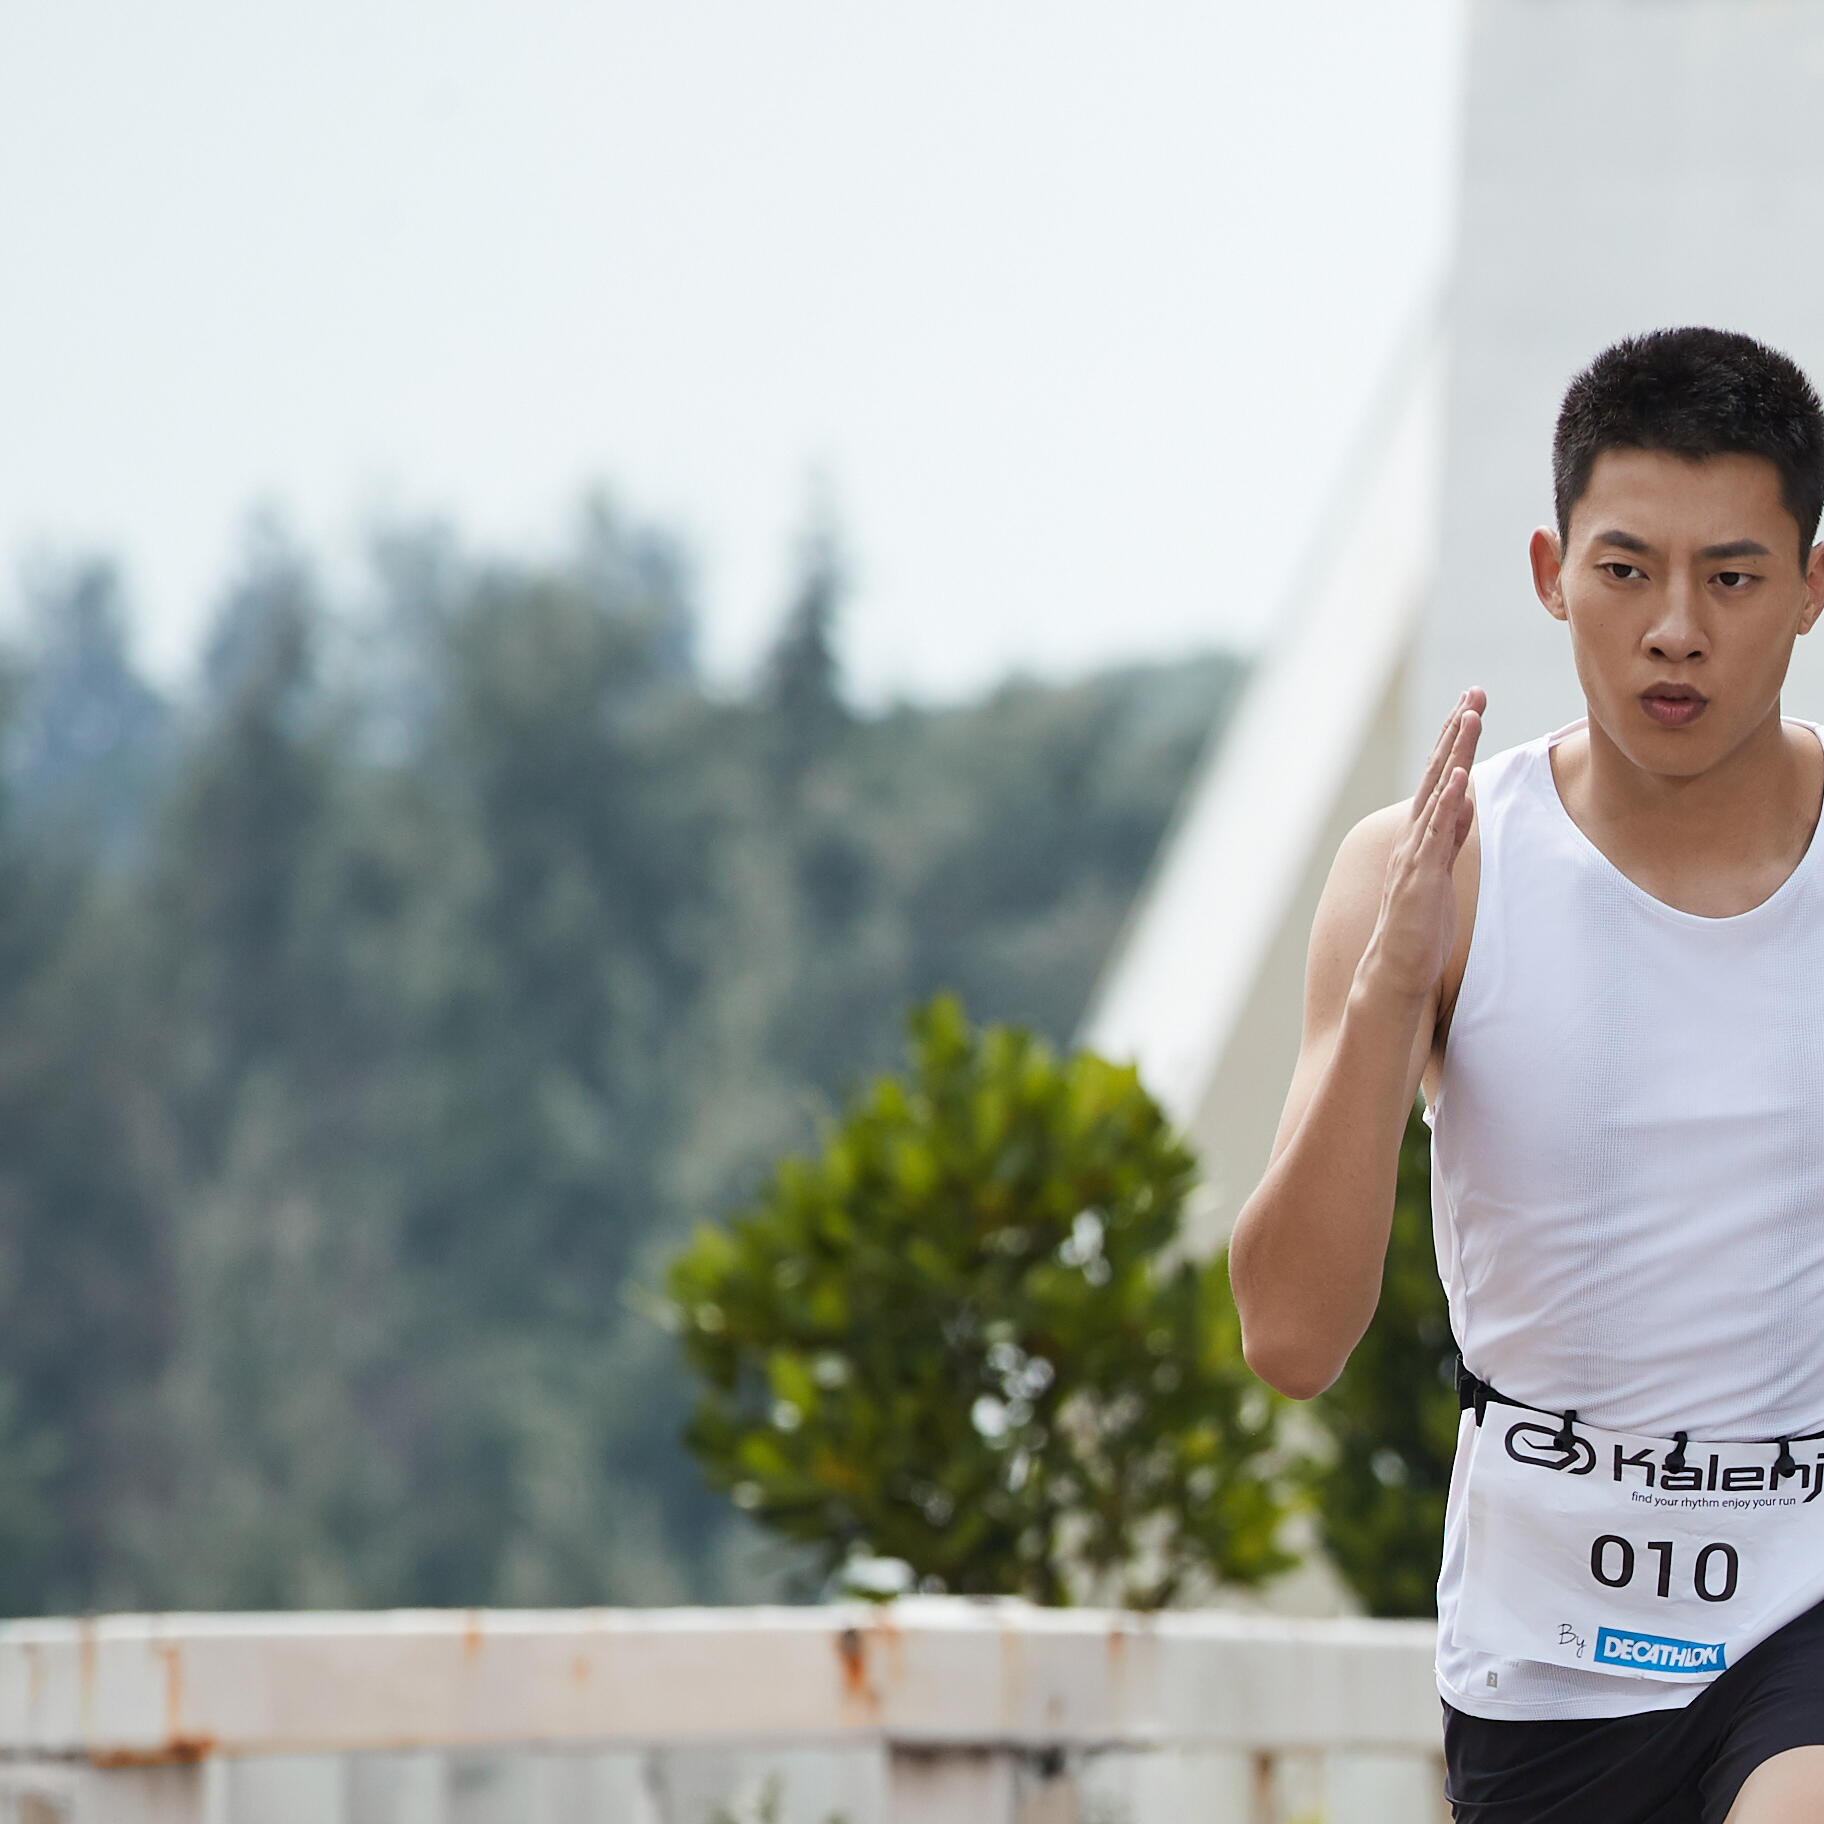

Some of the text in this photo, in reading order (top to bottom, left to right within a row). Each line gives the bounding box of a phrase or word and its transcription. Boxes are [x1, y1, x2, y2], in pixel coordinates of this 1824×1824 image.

[1632, 1491, 1797, 1510] find your rhythm enjoy your run
[1590, 1534, 1739, 1603] 010
[1558, 1623, 1720, 1668] By DECATHLON
